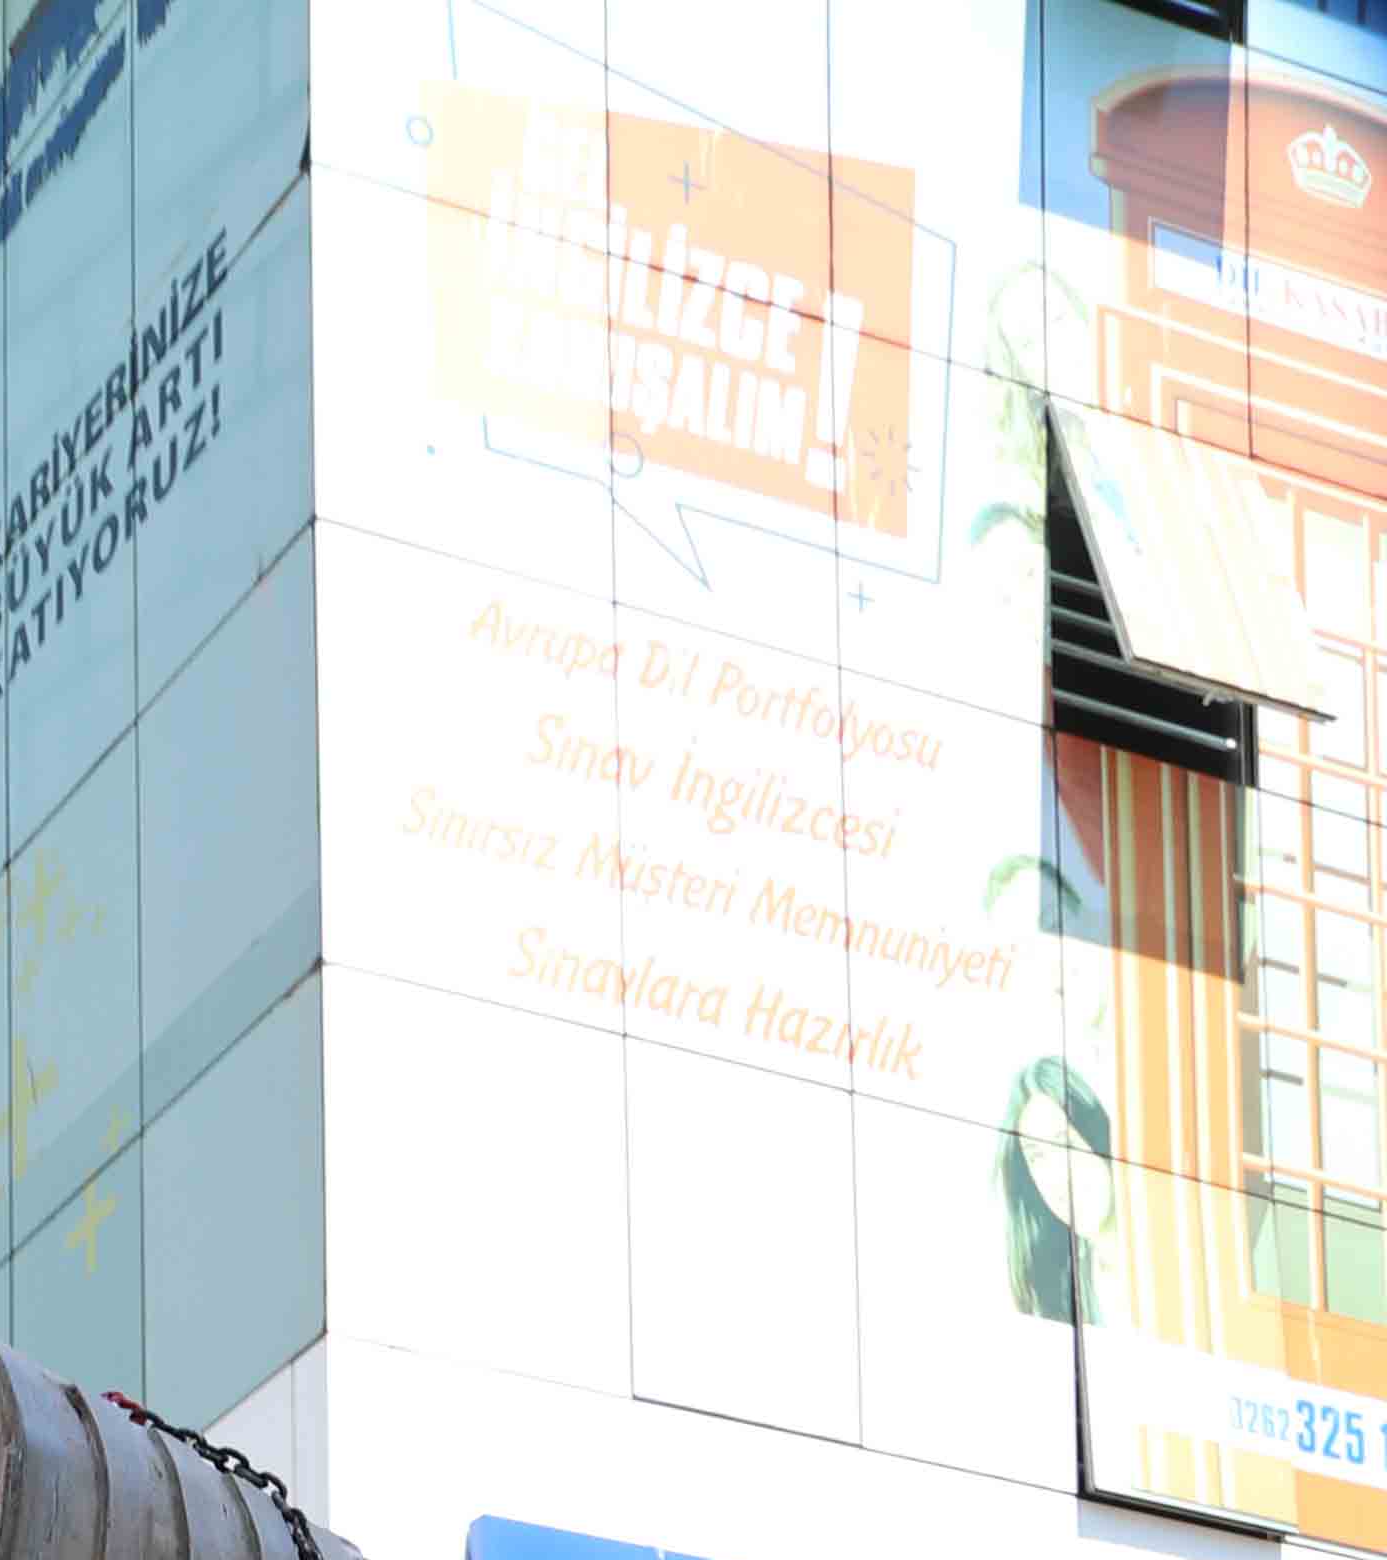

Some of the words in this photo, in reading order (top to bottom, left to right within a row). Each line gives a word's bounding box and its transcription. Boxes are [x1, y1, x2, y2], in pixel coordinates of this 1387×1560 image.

[128, 307, 223, 470] ARTI
[468, 598, 625, 682] Avrupa
[709, 657, 945, 772] Portfolyosu
[526, 711, 656, 790] Sınav
[668, 733, 904, 862] İngilizcesi
[507, 922, 731, 1031] Sınavlara
[747, 876, 1020, 994] Memnuniyeti
[1294, 1399, 1366, 1466] 325
